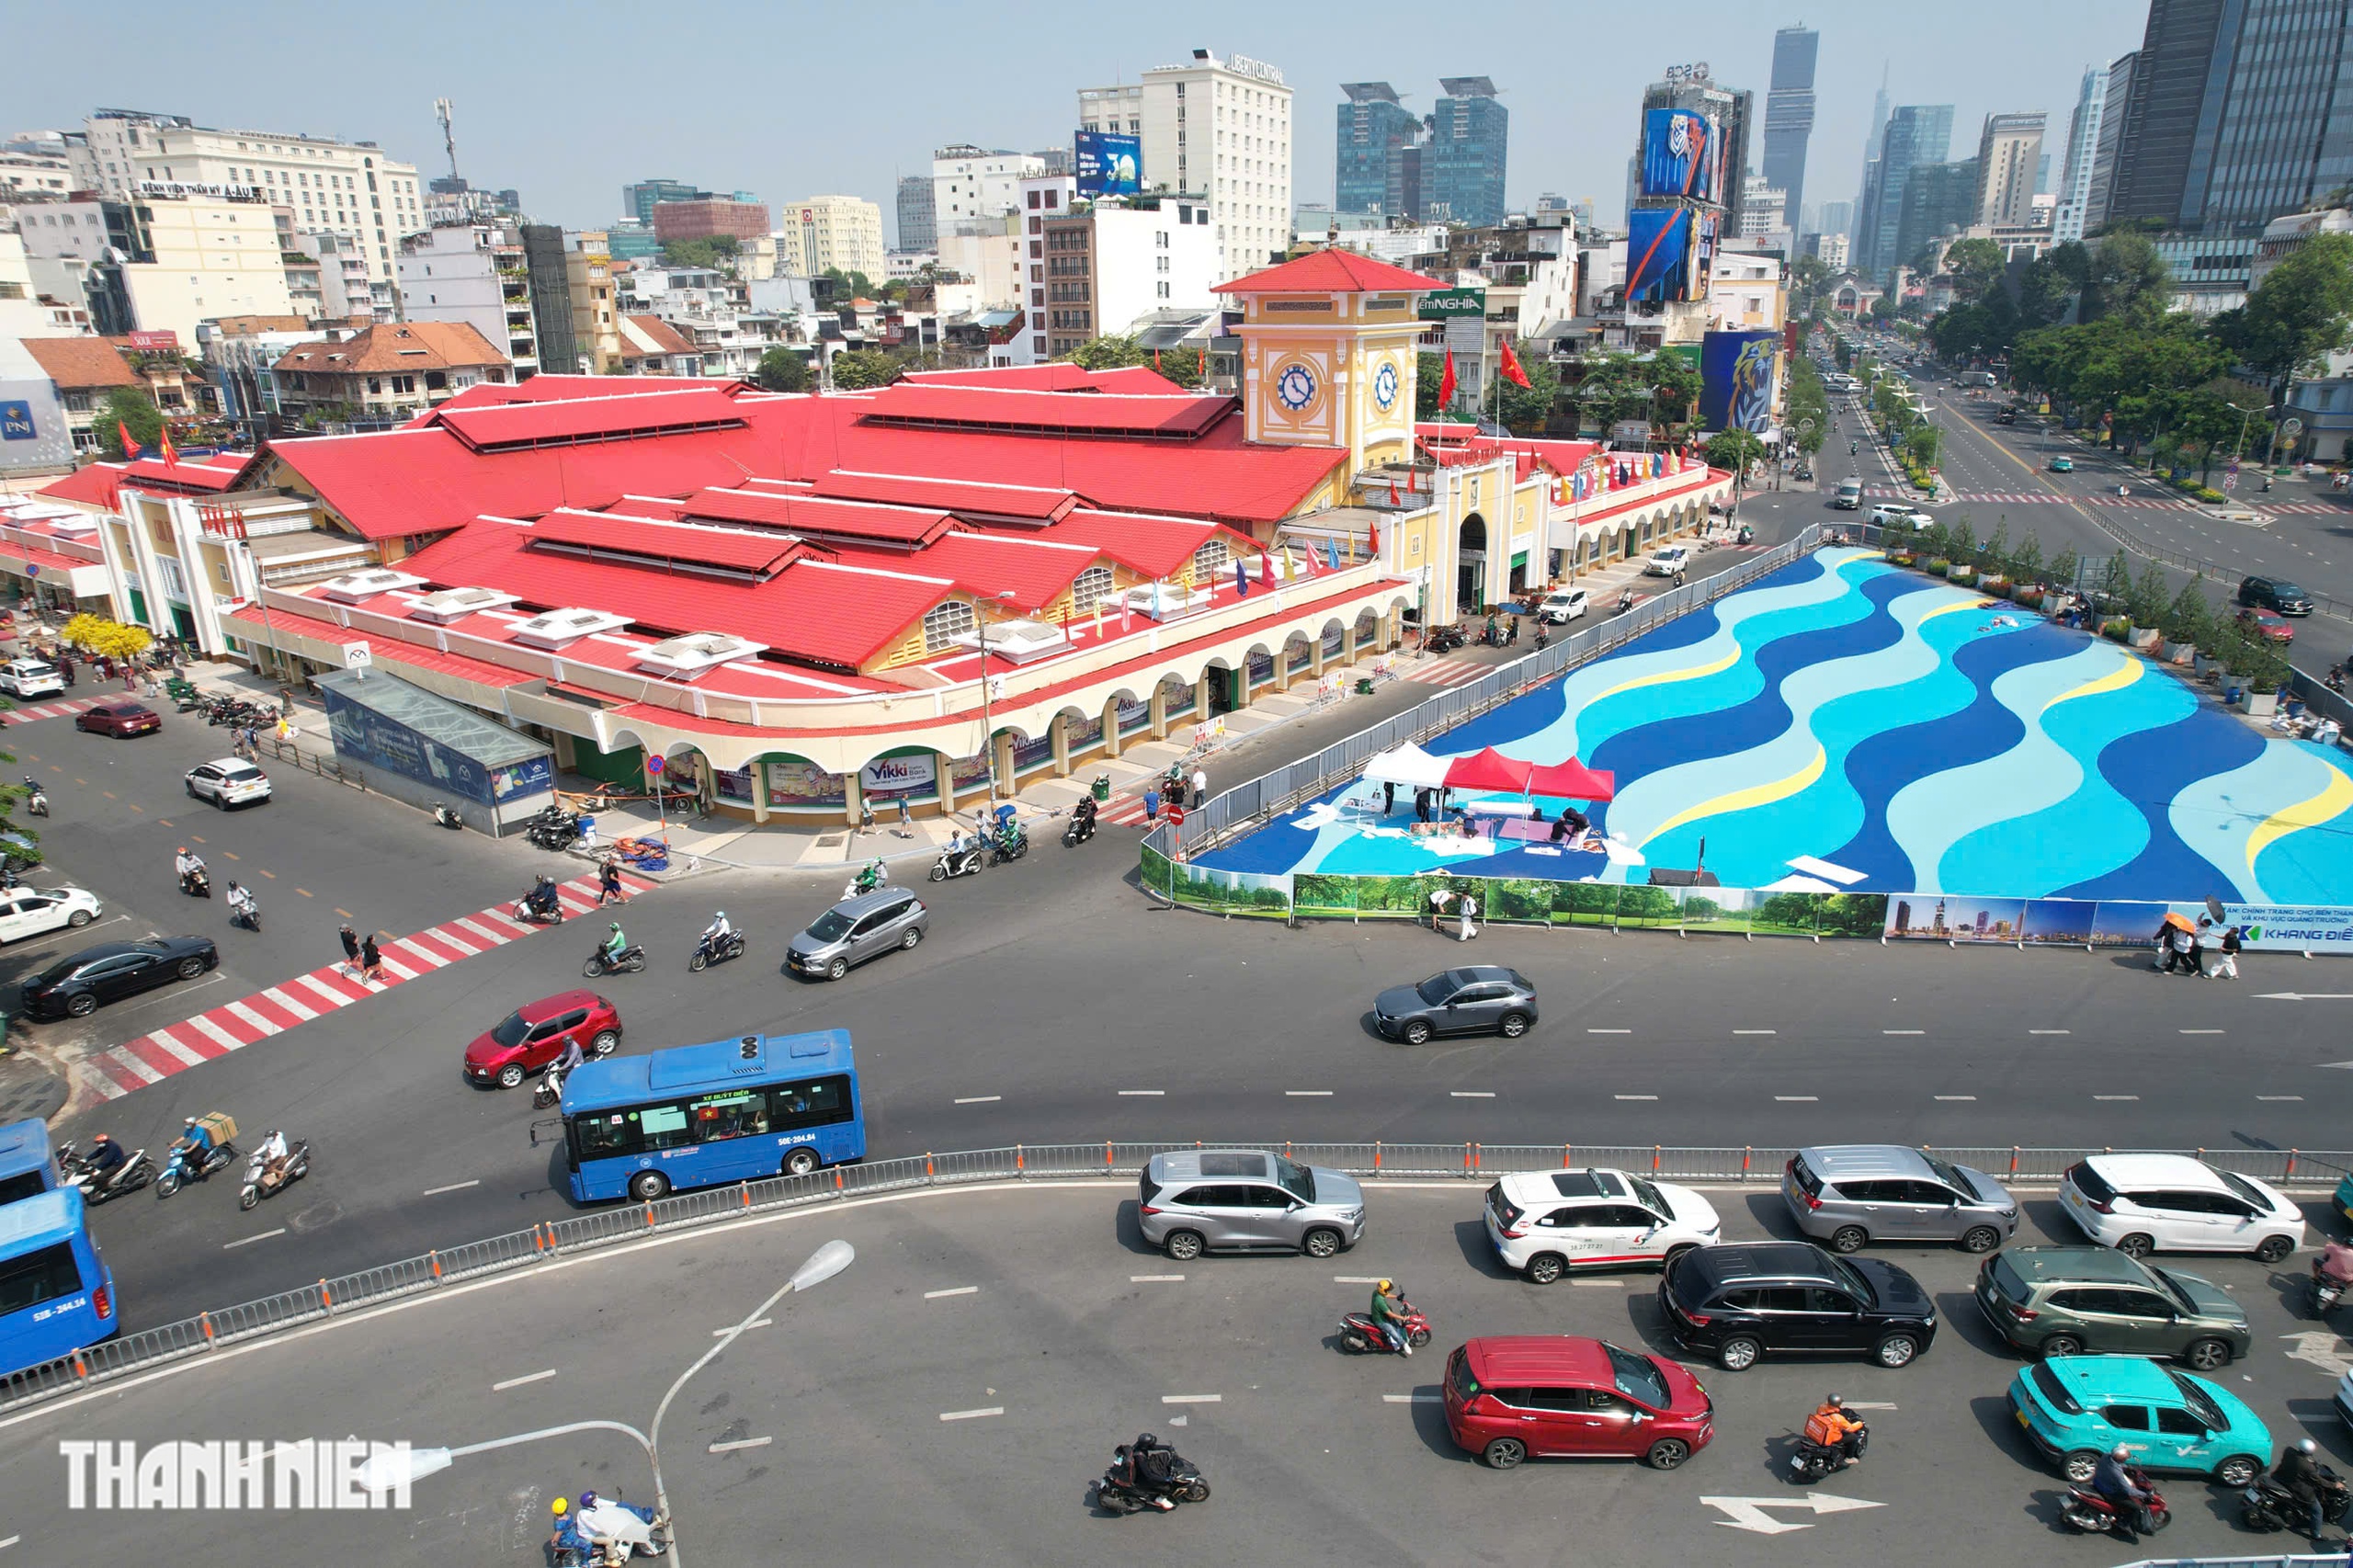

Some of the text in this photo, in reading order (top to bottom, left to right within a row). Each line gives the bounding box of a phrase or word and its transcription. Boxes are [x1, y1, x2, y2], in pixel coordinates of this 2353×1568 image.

[1419, 294, 1482, 310] ềmNGHĨA
[869, 757, 907, 779] Vikki
[2264, 926, 2353, 941] KHANG ĐIỀ
